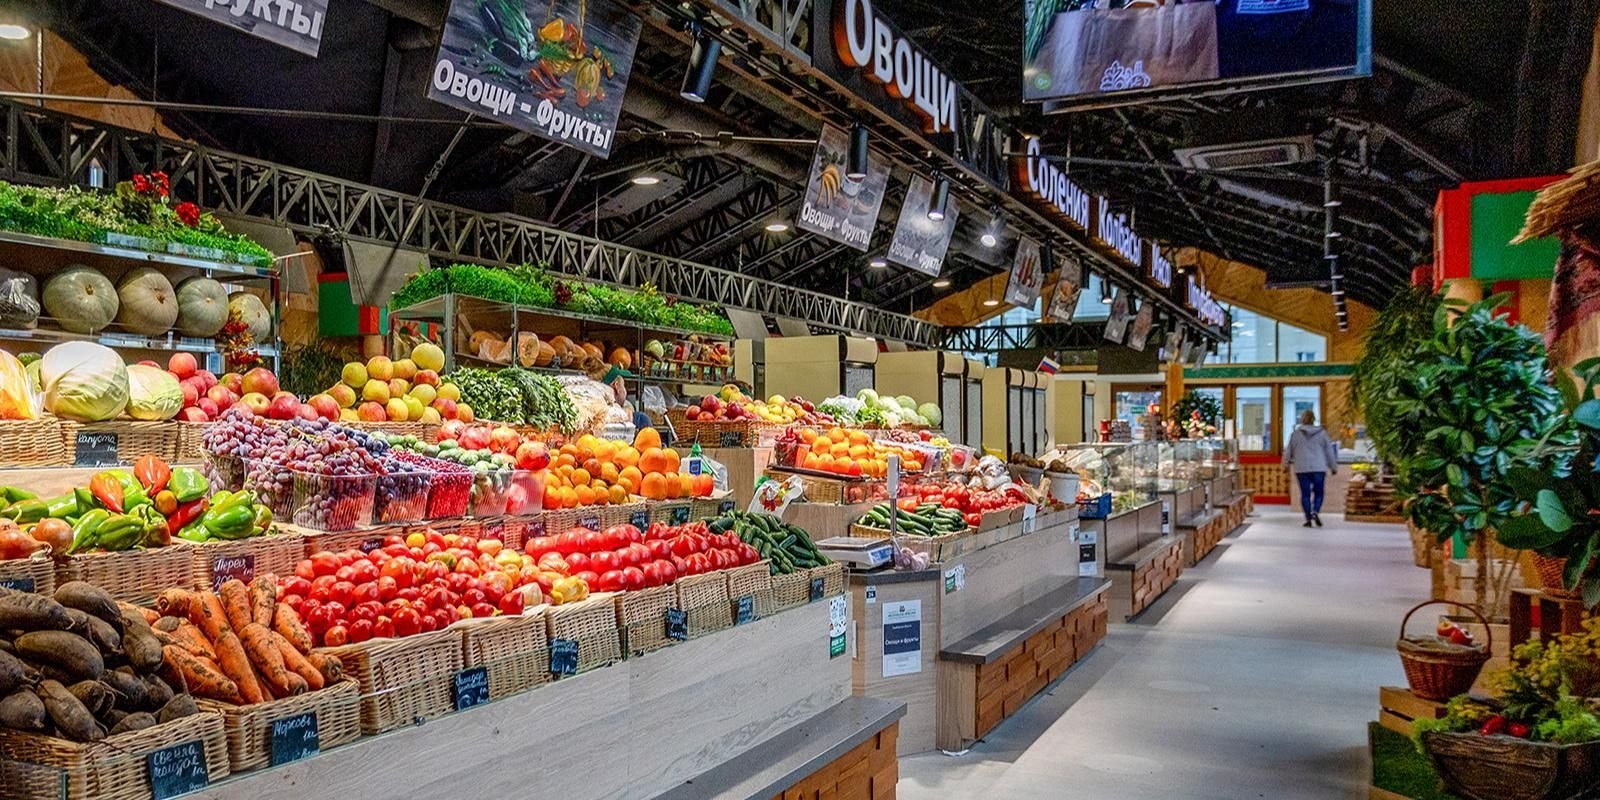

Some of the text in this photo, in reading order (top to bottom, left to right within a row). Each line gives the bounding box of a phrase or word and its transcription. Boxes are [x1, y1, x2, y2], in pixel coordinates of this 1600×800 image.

[434, 59, 517, 116] Овощи
[845, 0, 956, 133] Овощи
[802, 201, 835, 233] Овощи
[1027, 136, 1090, 231] Соления
